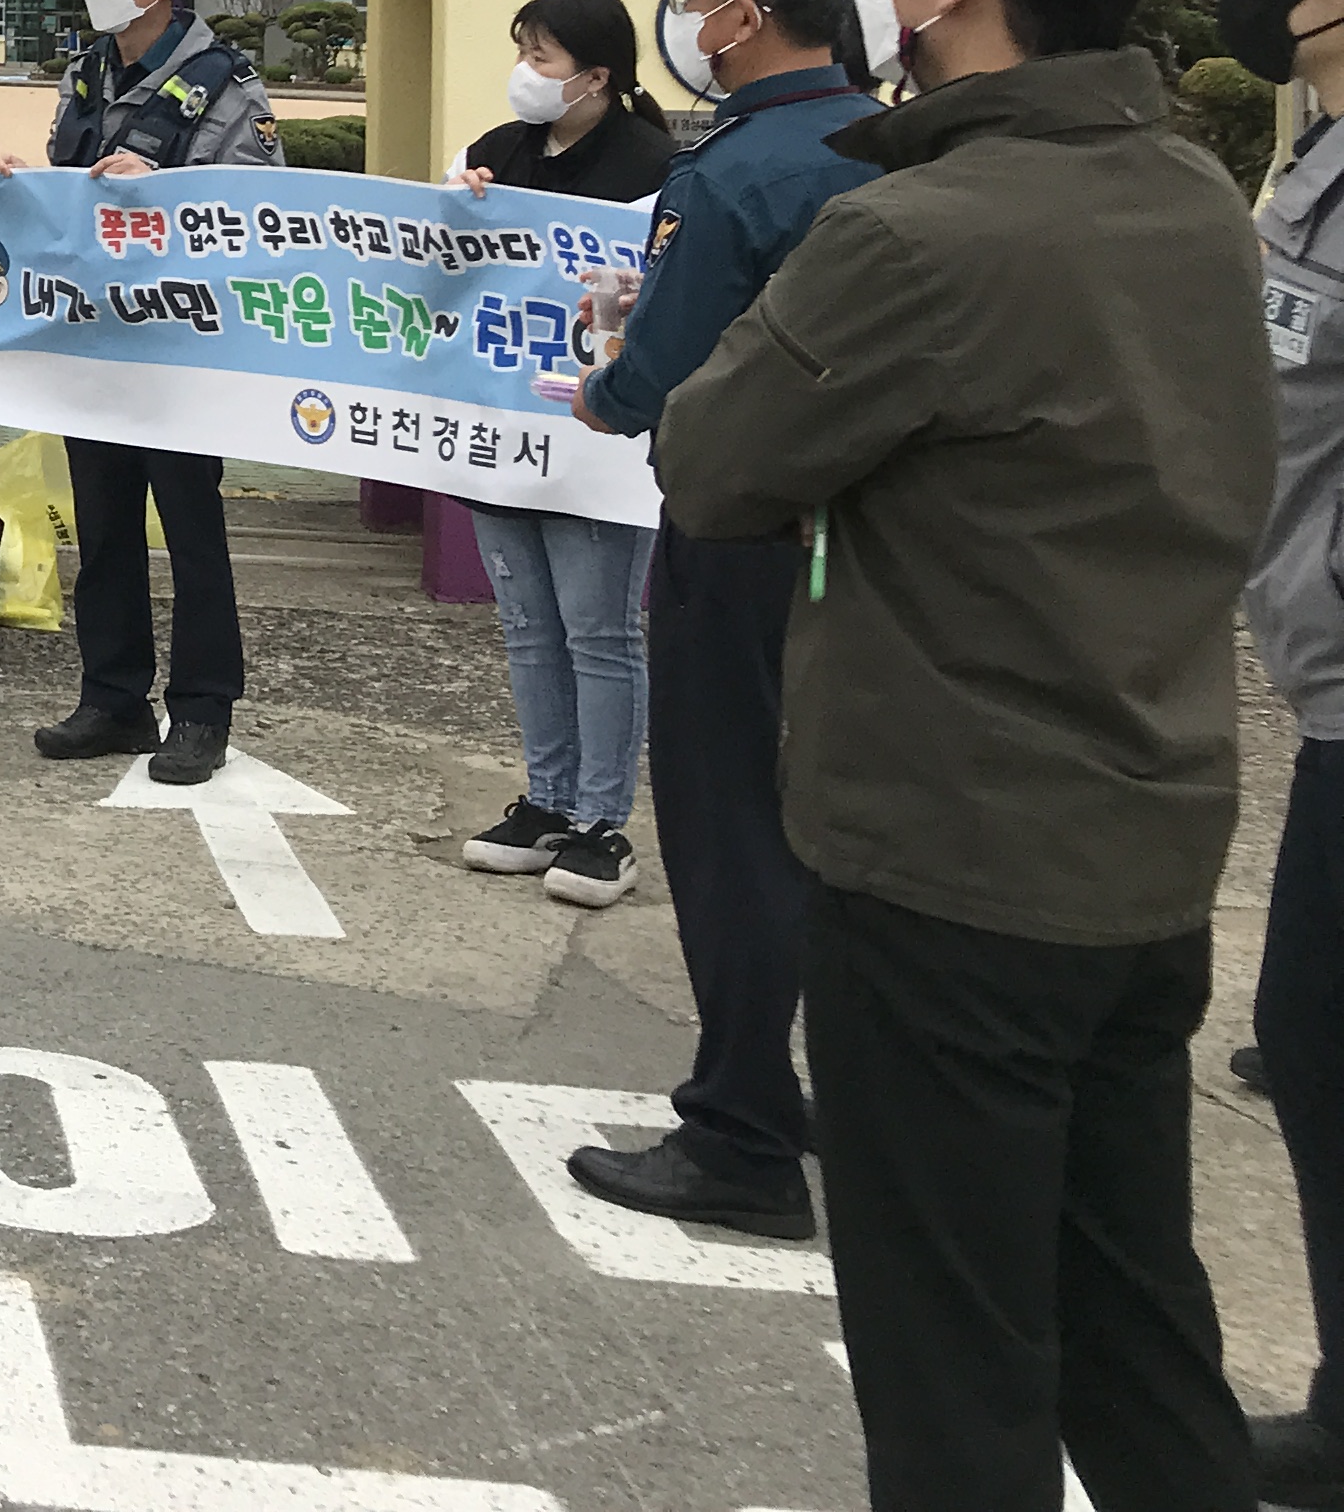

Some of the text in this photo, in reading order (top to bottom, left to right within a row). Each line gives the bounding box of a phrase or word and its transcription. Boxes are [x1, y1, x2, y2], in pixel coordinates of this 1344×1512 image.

[99, 207, 166, 253] 폭력
[180, 207, 246, 252] 없는
[258, 207, 322, 251] 우리
[329, 210, 392, 256] 학교
[398, 221, 541, 271] 교실마다
[22, 268, 99, 323] 내가
[109, 280, 219, 332] 내민
[230, 276, 331, 343] 작은
[349, 401, 551, 477] 합천경찰서
